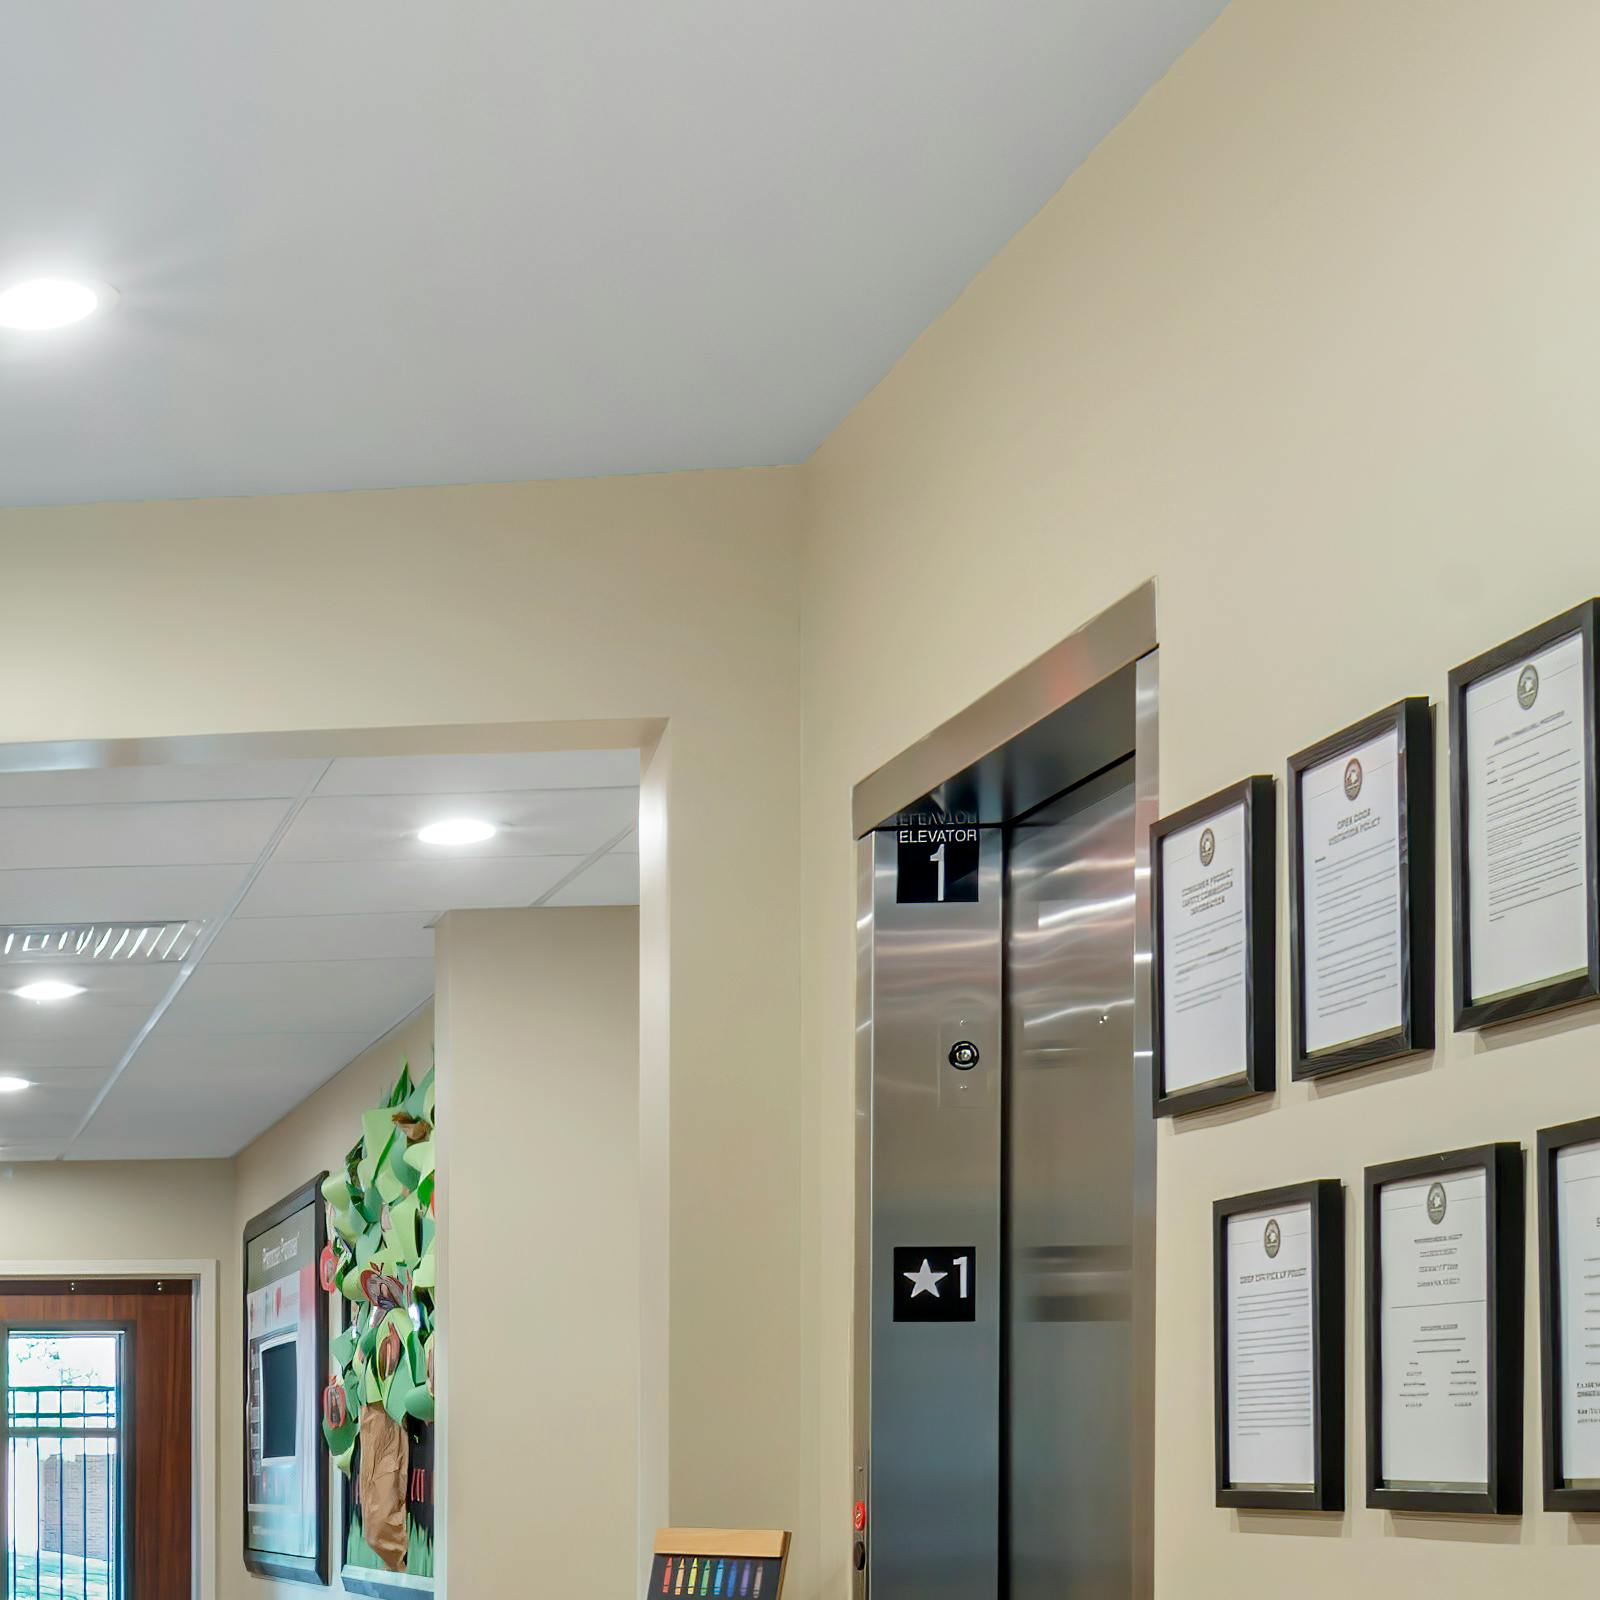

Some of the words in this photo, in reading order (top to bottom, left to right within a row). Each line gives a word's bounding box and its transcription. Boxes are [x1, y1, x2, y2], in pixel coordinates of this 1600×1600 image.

[899, 829, 977, 843] ELEVATOR
[930, 843, 945, 902] 1
[952, 1256, 968, 1298] 1
